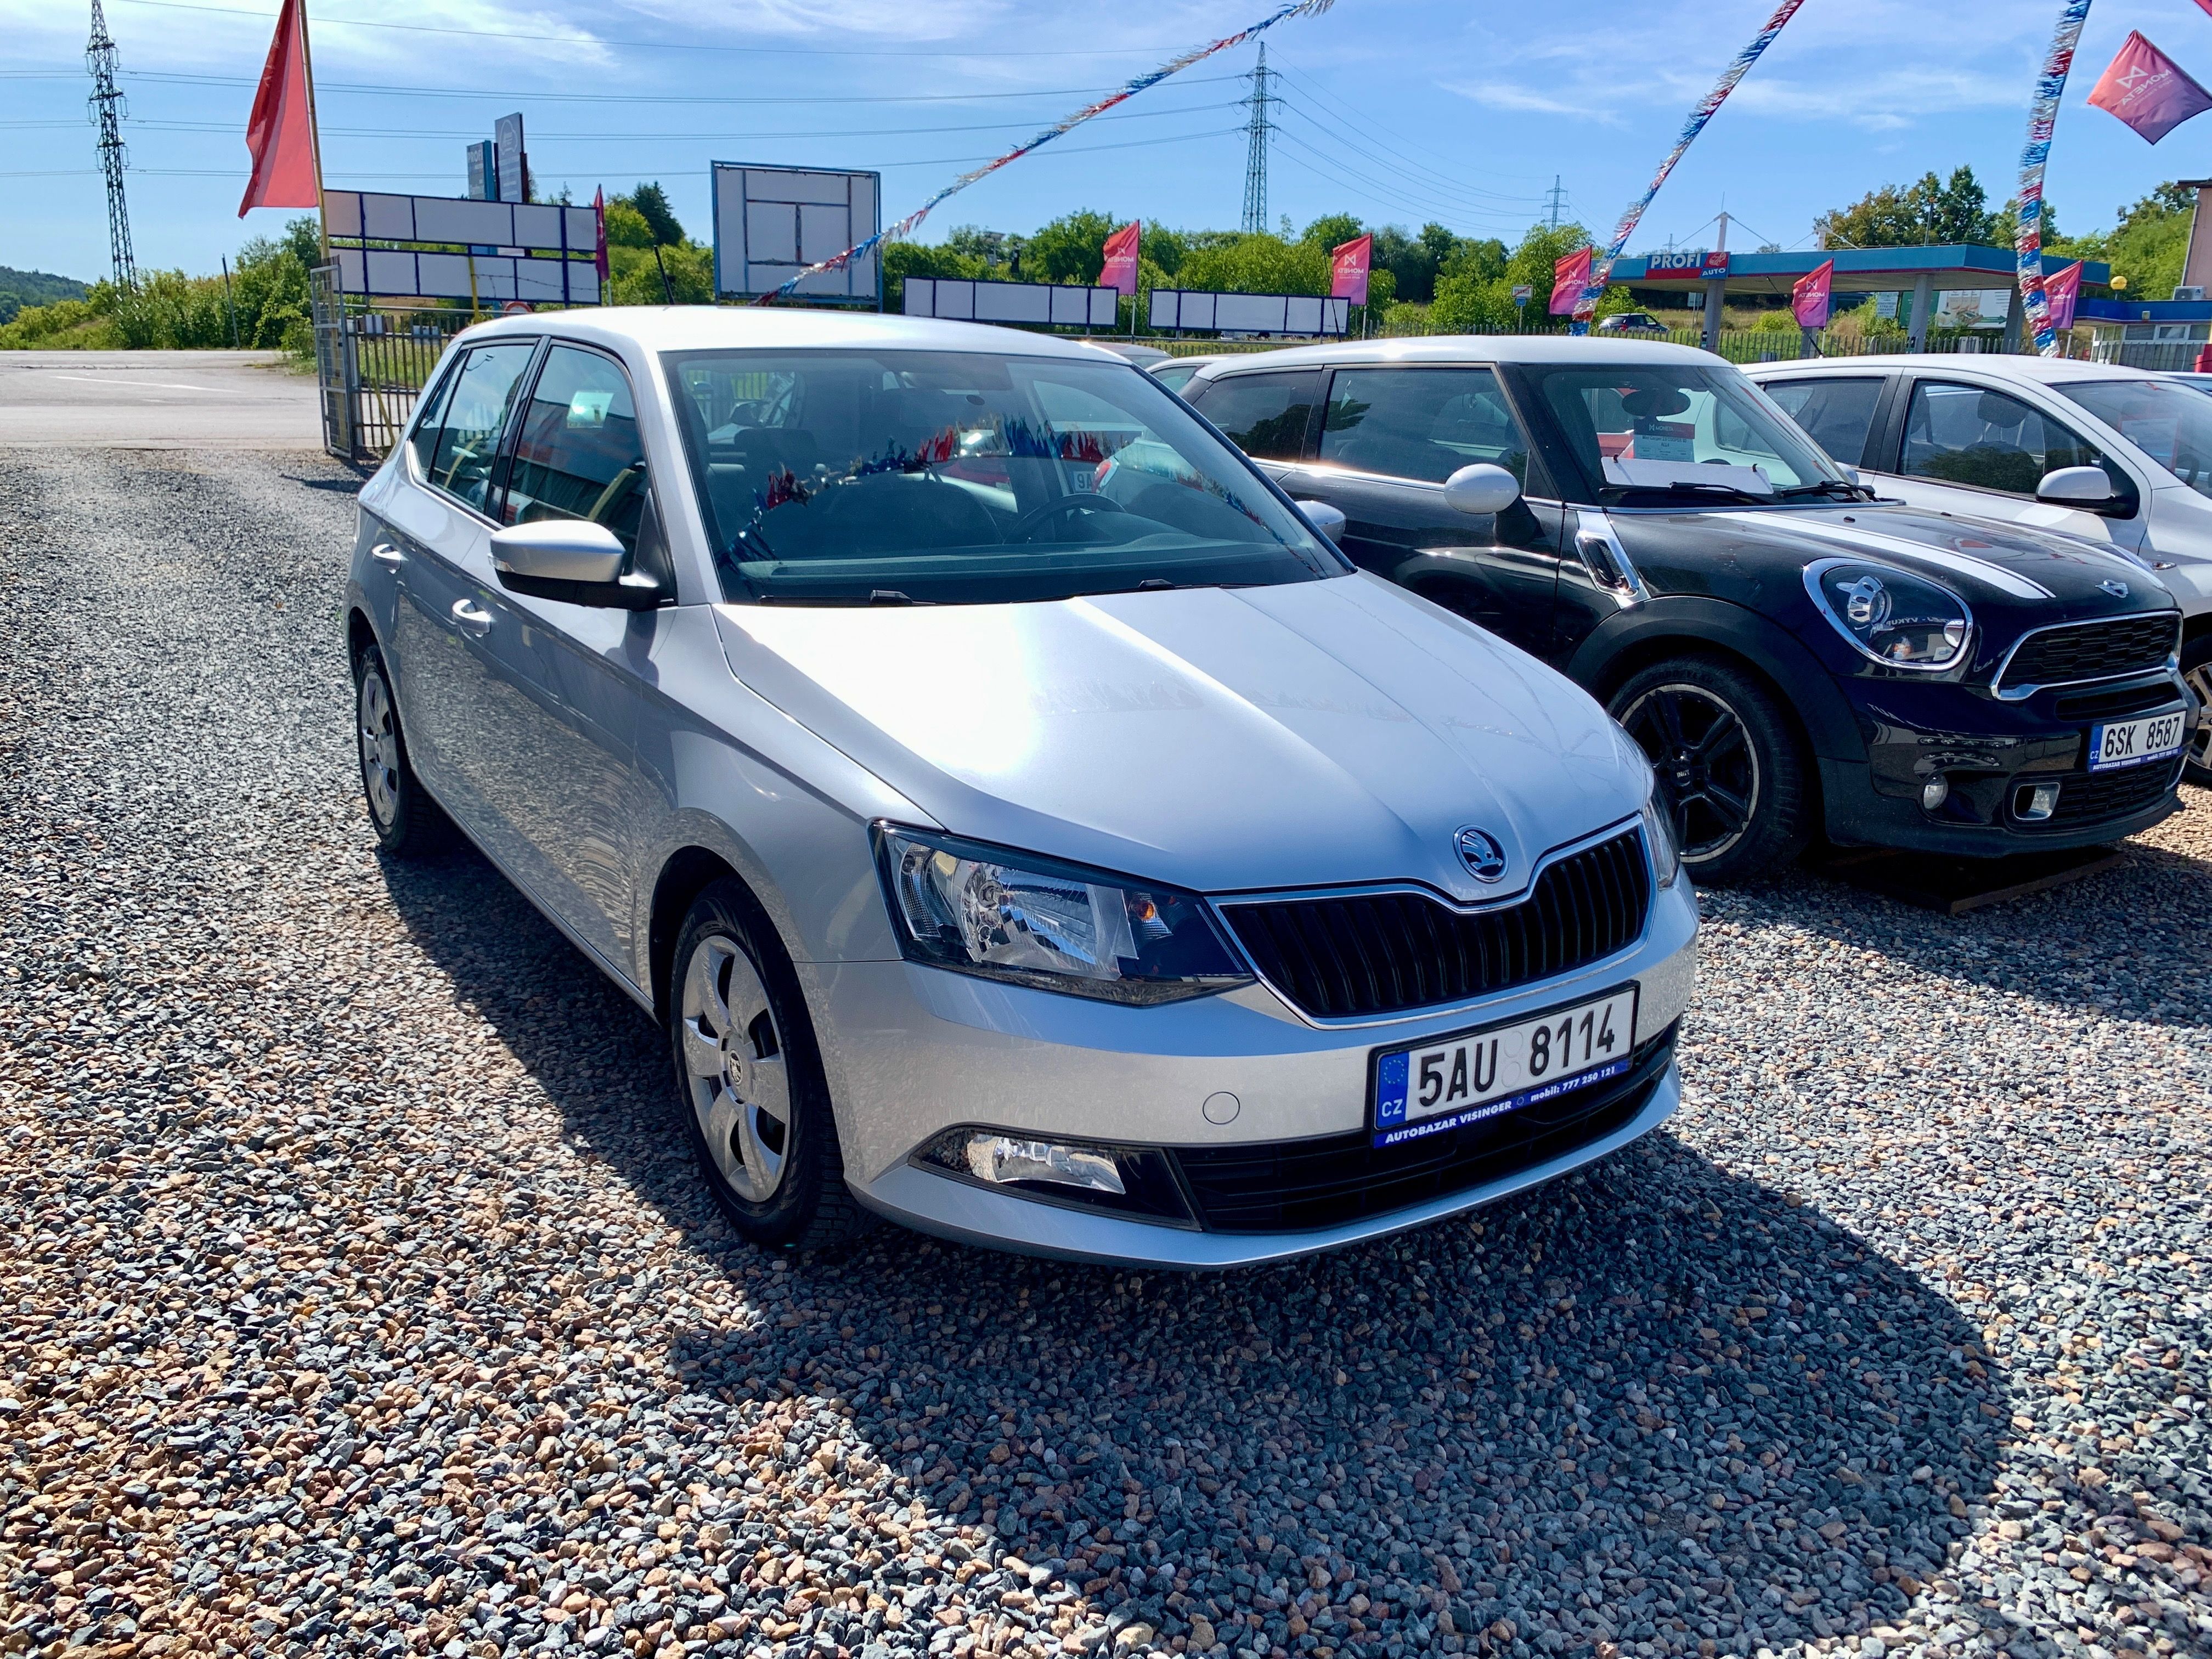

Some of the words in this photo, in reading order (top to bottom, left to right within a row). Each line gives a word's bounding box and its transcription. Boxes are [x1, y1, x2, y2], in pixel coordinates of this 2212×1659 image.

[1651, 253, 1701, 269] PROFI
[1702, 268, 1726, 276] AUTO
[2105, 725, 2136, 757] 6SK
[2147, 716, 2180, 749] 8587
[2090, 750, 2099, 760] CZ
[1419, 1039, 1498, 1107] 5AU
[1530, 1003, 1615, 1076] 8114
[1382, 1099, 1403, 1118] CZ
[1385, 1118, 1457, 1143] AUTOBAZAR
[1459, 1101, 1512, 1124] VISINGER
[1531, 1085, 1560, 1102] mobil:
[1563, 1079, 1579, 1091] 777
[1582, 1072, 1598, 1085] 250
[1601, 1066, 1615, 1077] 121
